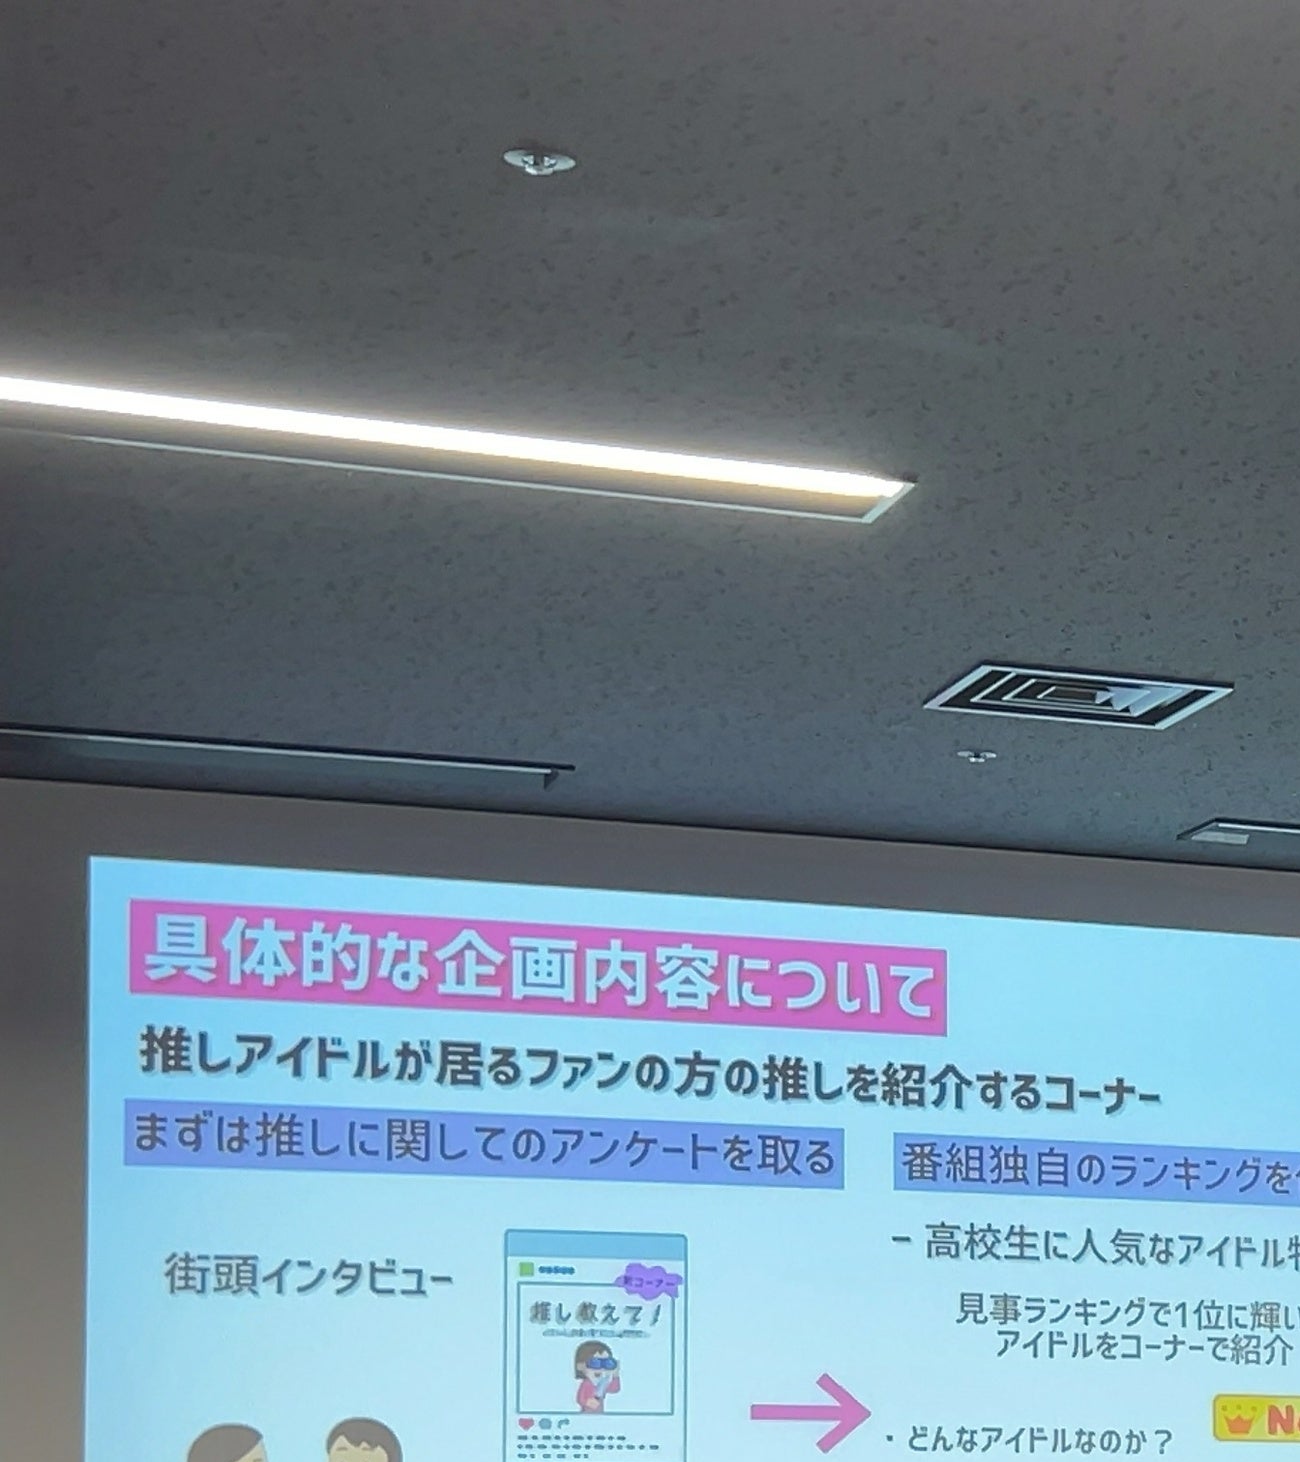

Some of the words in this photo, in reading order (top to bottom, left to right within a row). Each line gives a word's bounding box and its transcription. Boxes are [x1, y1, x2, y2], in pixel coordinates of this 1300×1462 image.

[144, 912, 936, 1019] 具体的な企画内容について
[139, 1024, 1162, 1116] 推しアイドルが居るファンの方の推しを紹介するコーナー
[134, 1111, 836, 1177] まずは推しに関してのアンケートを取る
[164, 1250, 455, 1299] 街頭インタビュー
[996, 1329, 1294, 1367] アイドルをコーナーで紹介
